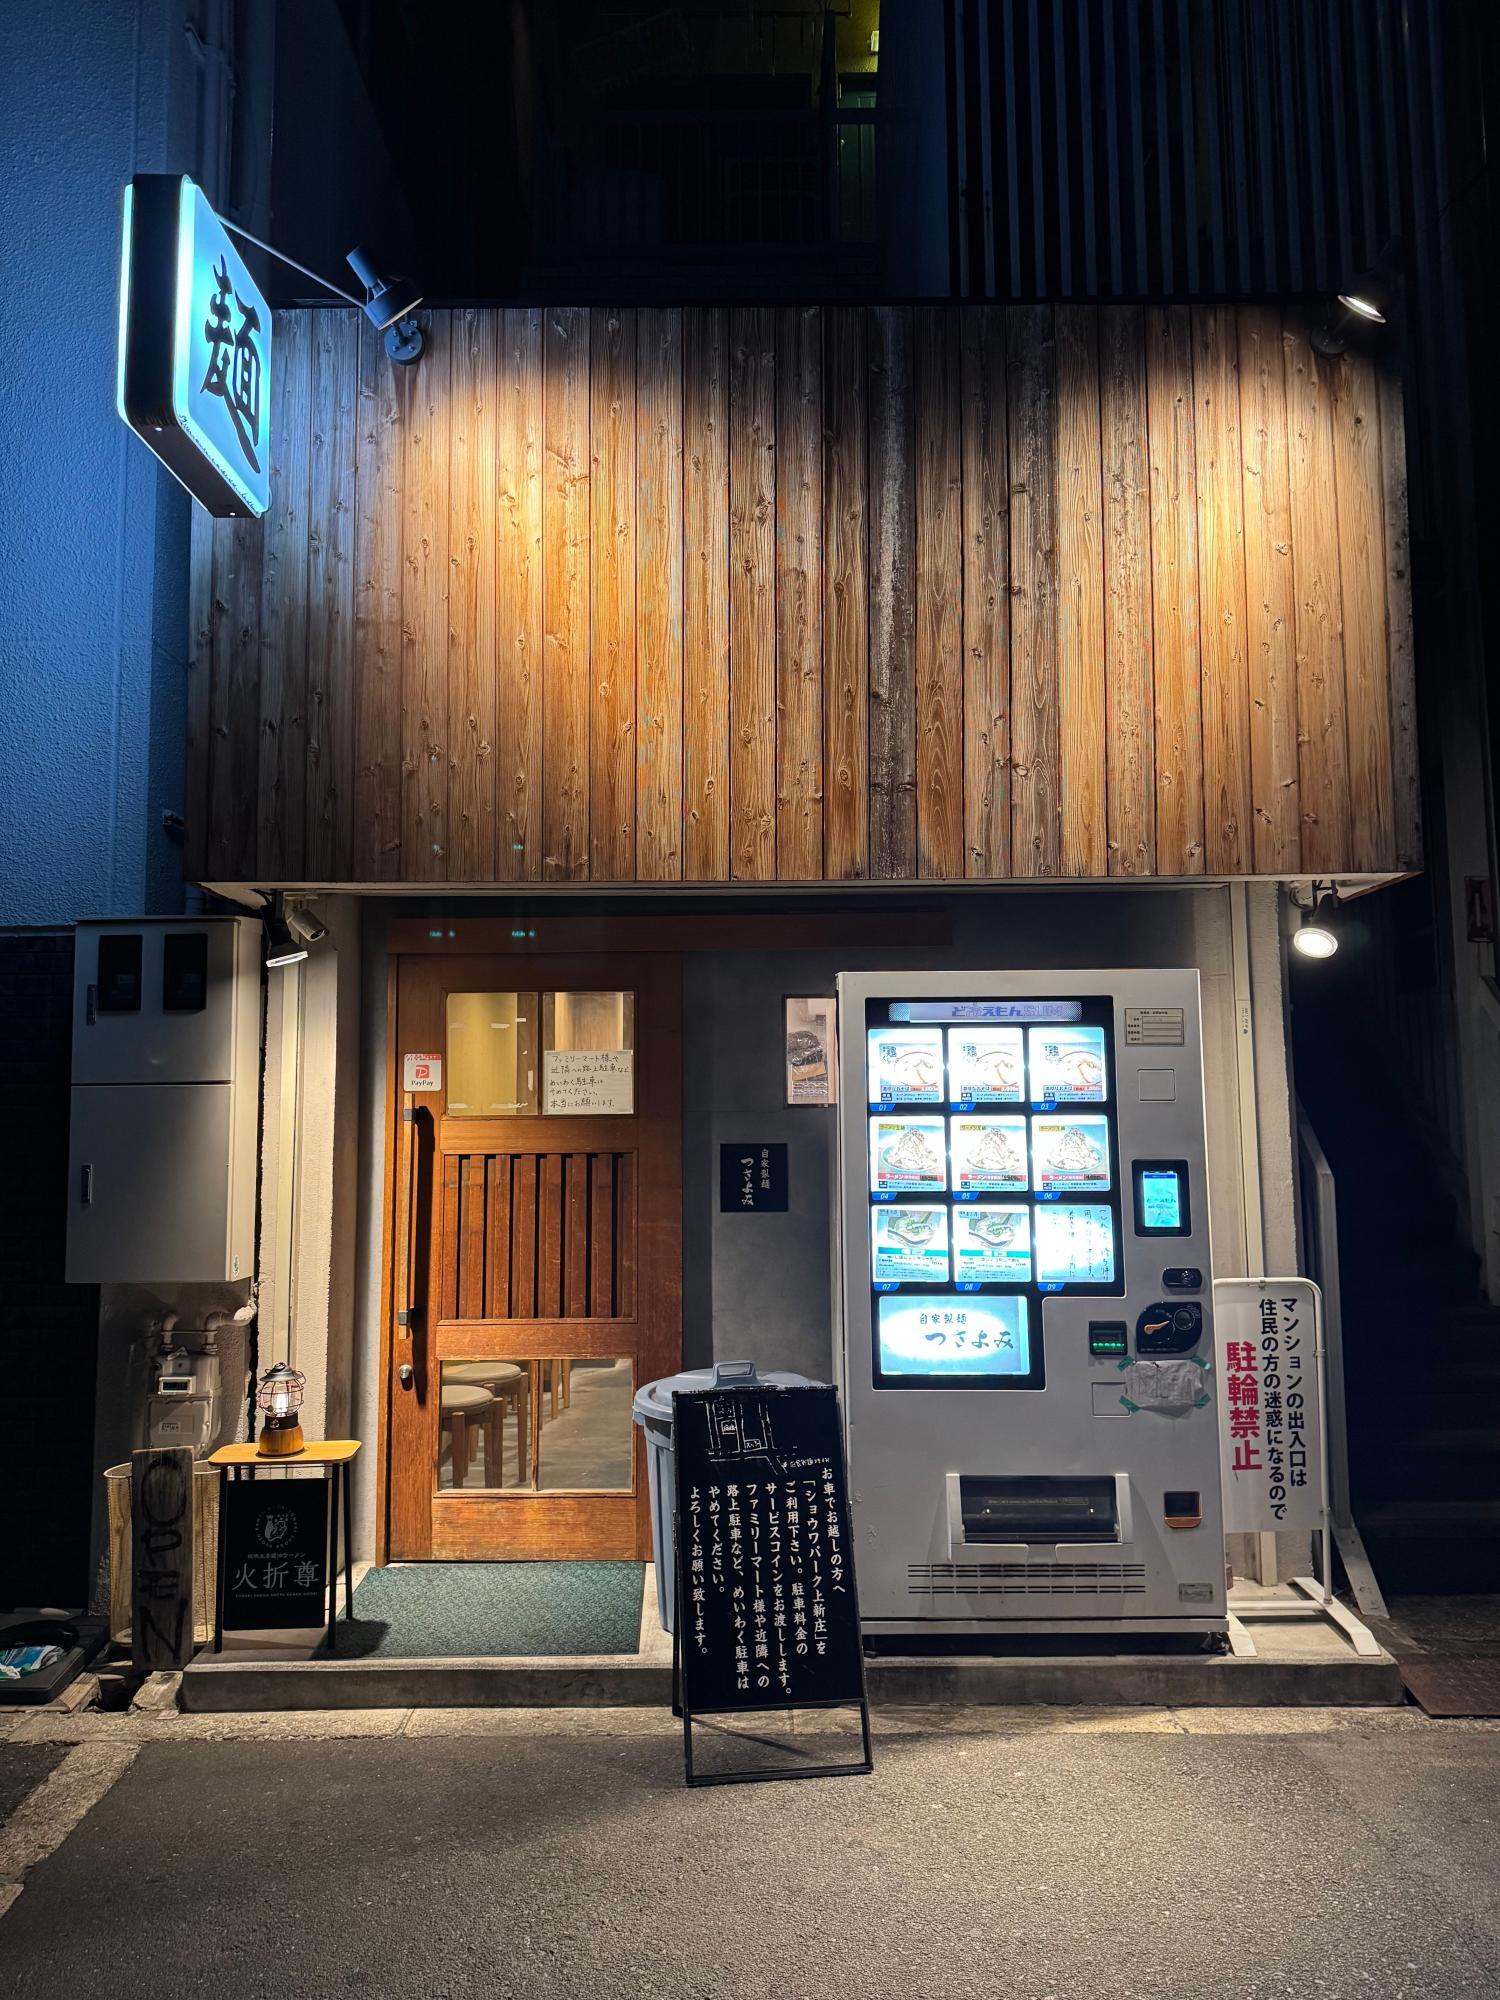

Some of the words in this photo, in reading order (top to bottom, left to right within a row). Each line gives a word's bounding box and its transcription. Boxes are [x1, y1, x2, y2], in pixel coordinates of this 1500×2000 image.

[200, 253, 261, 474] 麺
[960, 1103, 968, 1111] 02
[880, 1192, 889, 1200] 04
[961, 1192, 970, 1200] 05
[1043, 1192, 1053, 1200] 06
[919, 1313, 967, 1325] 自家製麺
[1047, 1283, 1056, 1291] 09
[1226, 1341, 1262, 1470] 駐輪禁止
[1259, 1299, 1288, 1520] 住民の方の迷惑になるので
[1281, 1298, 1307, 1486] マンションの出入口は
[231, 1561, 319, 1591] 火折尊
[689, 1486, 708, 1654] よろしくお願い致します。
[708, 1485, 725, 1593] やめてください。
[726, 1484, 750, 1689] 路上駐車など、めいわく駐車は
[746, 1484, 770, 1688] ファミリーマート様や近隣への
[765, 1482, 792, 1694] サービスコインをお渡しします。
[785, 1480, 809, 1655] ご利用下さい。駐車料金の
[822, 1467, 846, 1592] お車でお越しの方へ
